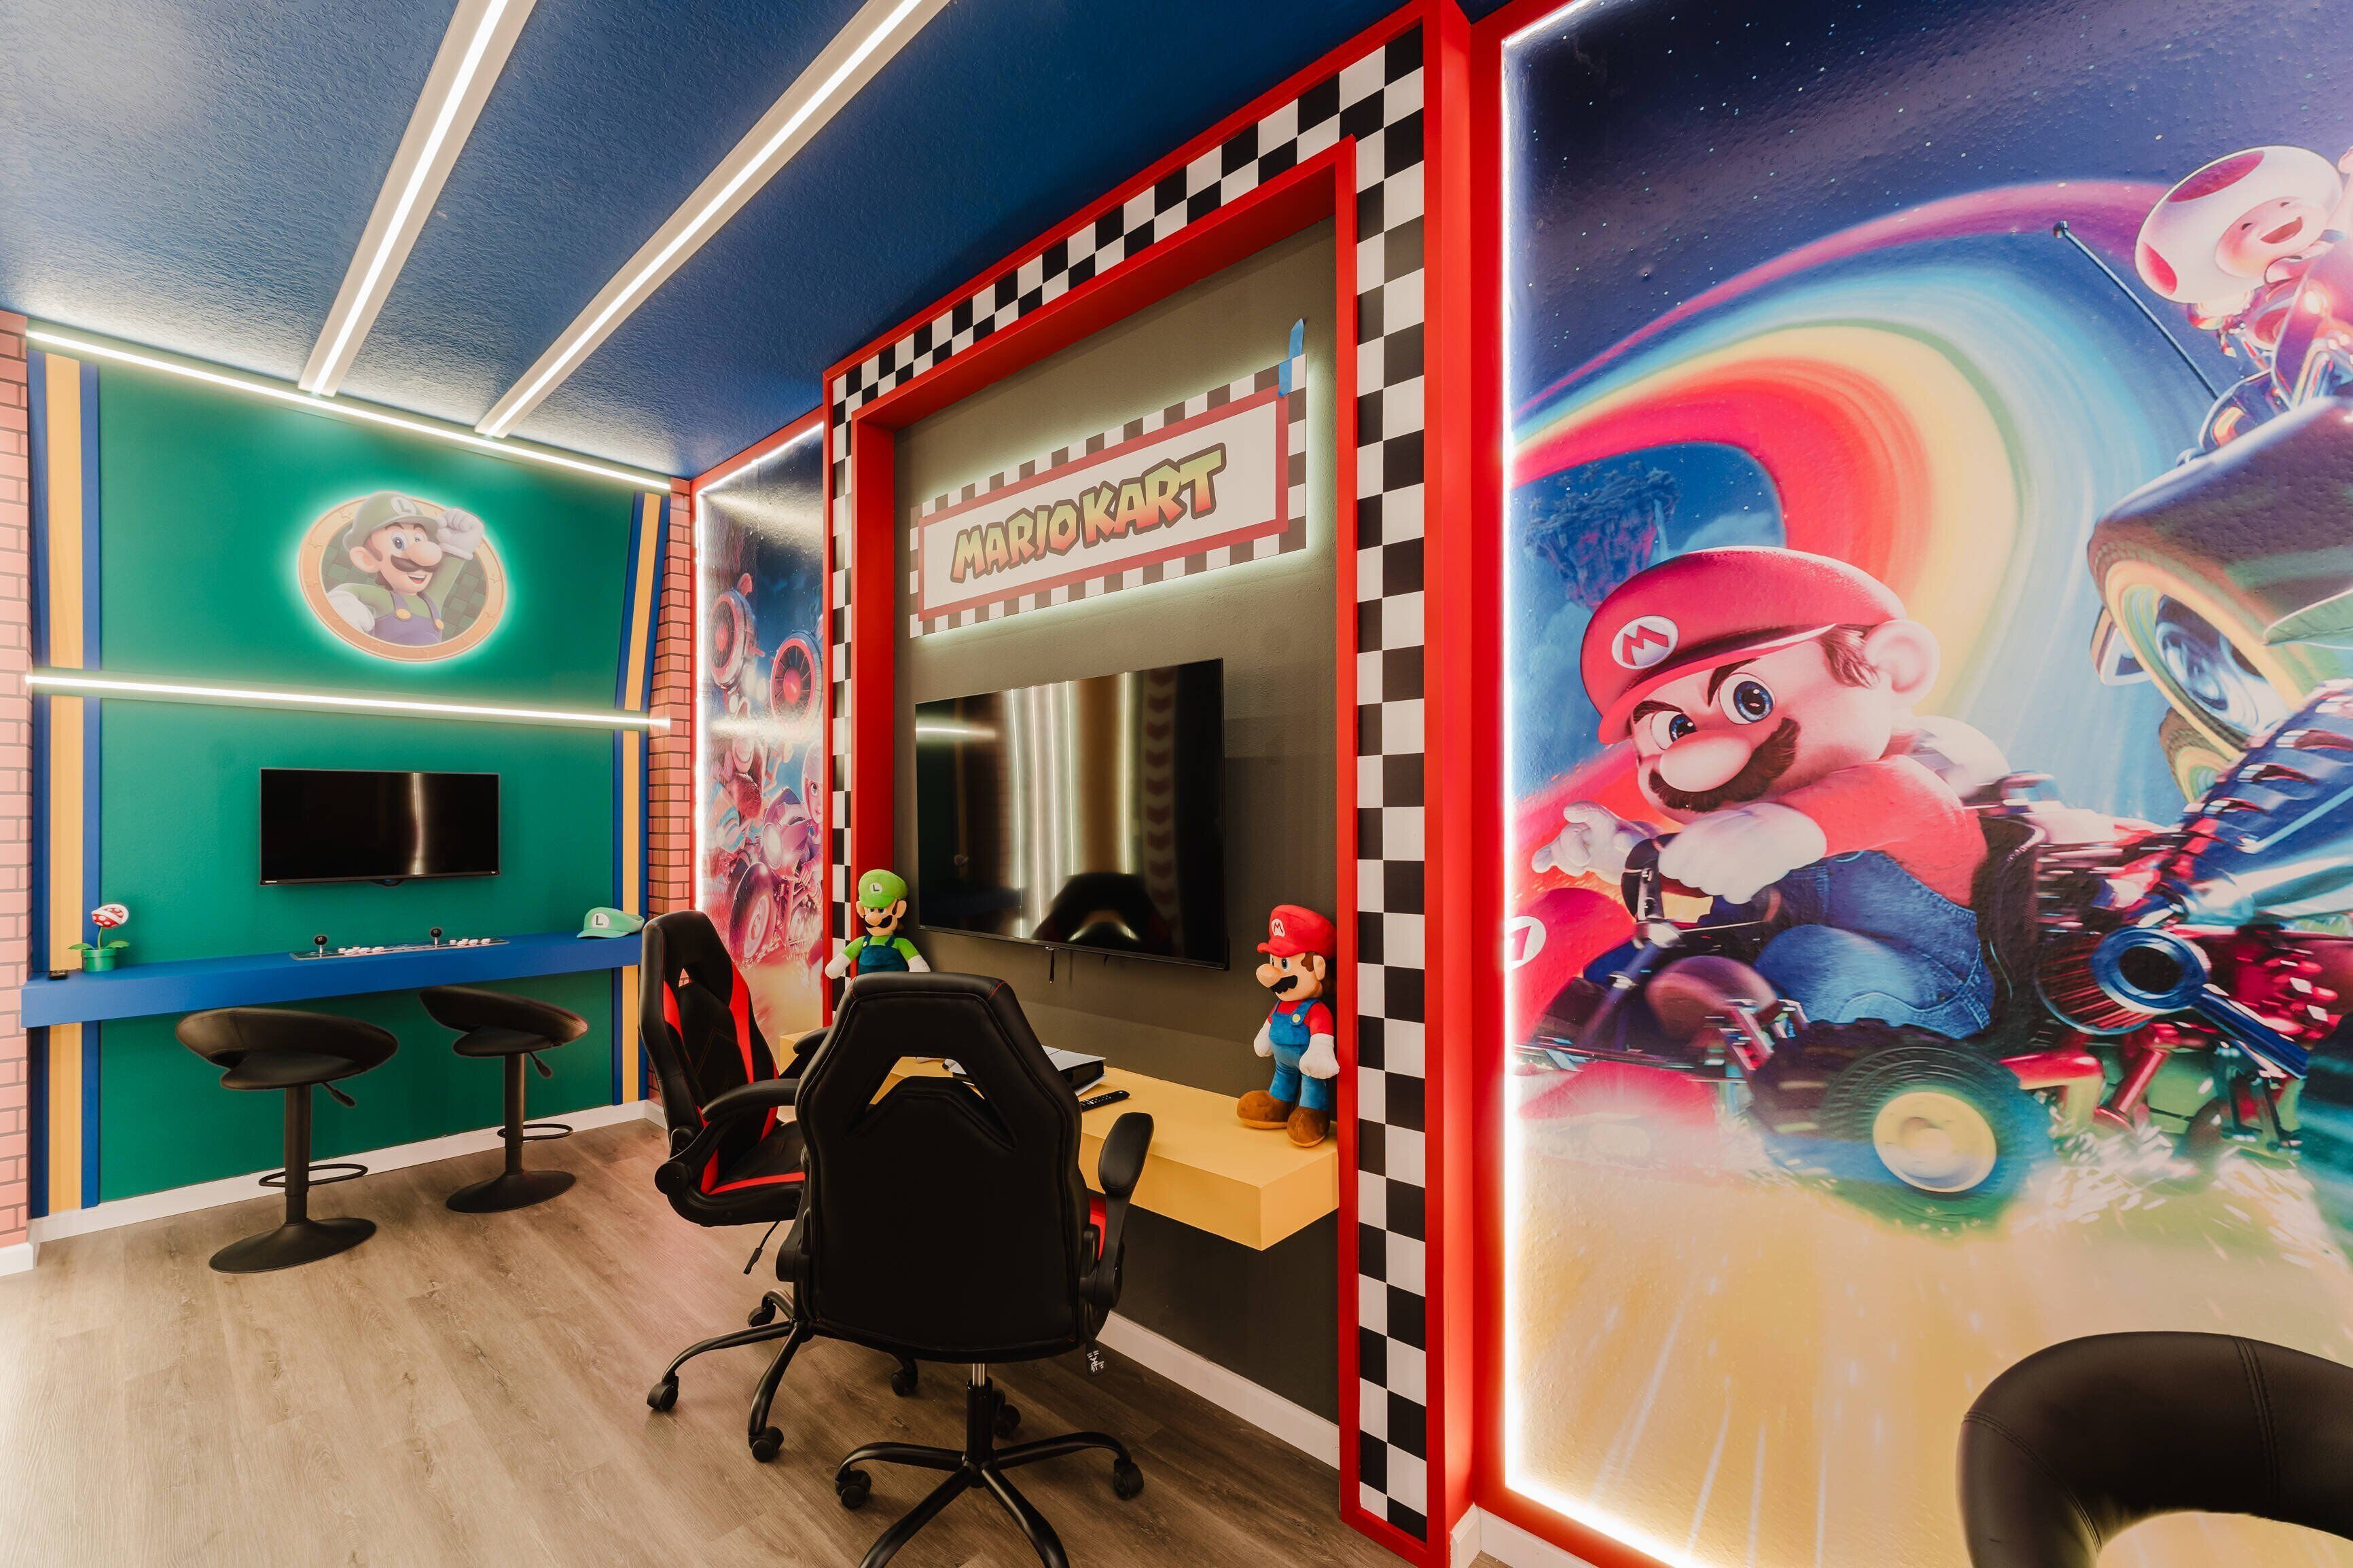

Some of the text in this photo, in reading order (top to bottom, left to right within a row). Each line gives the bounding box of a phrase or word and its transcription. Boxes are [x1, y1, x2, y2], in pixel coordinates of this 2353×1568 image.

[950, 442, 1226, 583] MARIO KART
[1622, 625, 1669, 666] M
[872, 883, 880, 892] L
[596, 915, 604, 926] L
[1274, 922, 1284, 934] M
